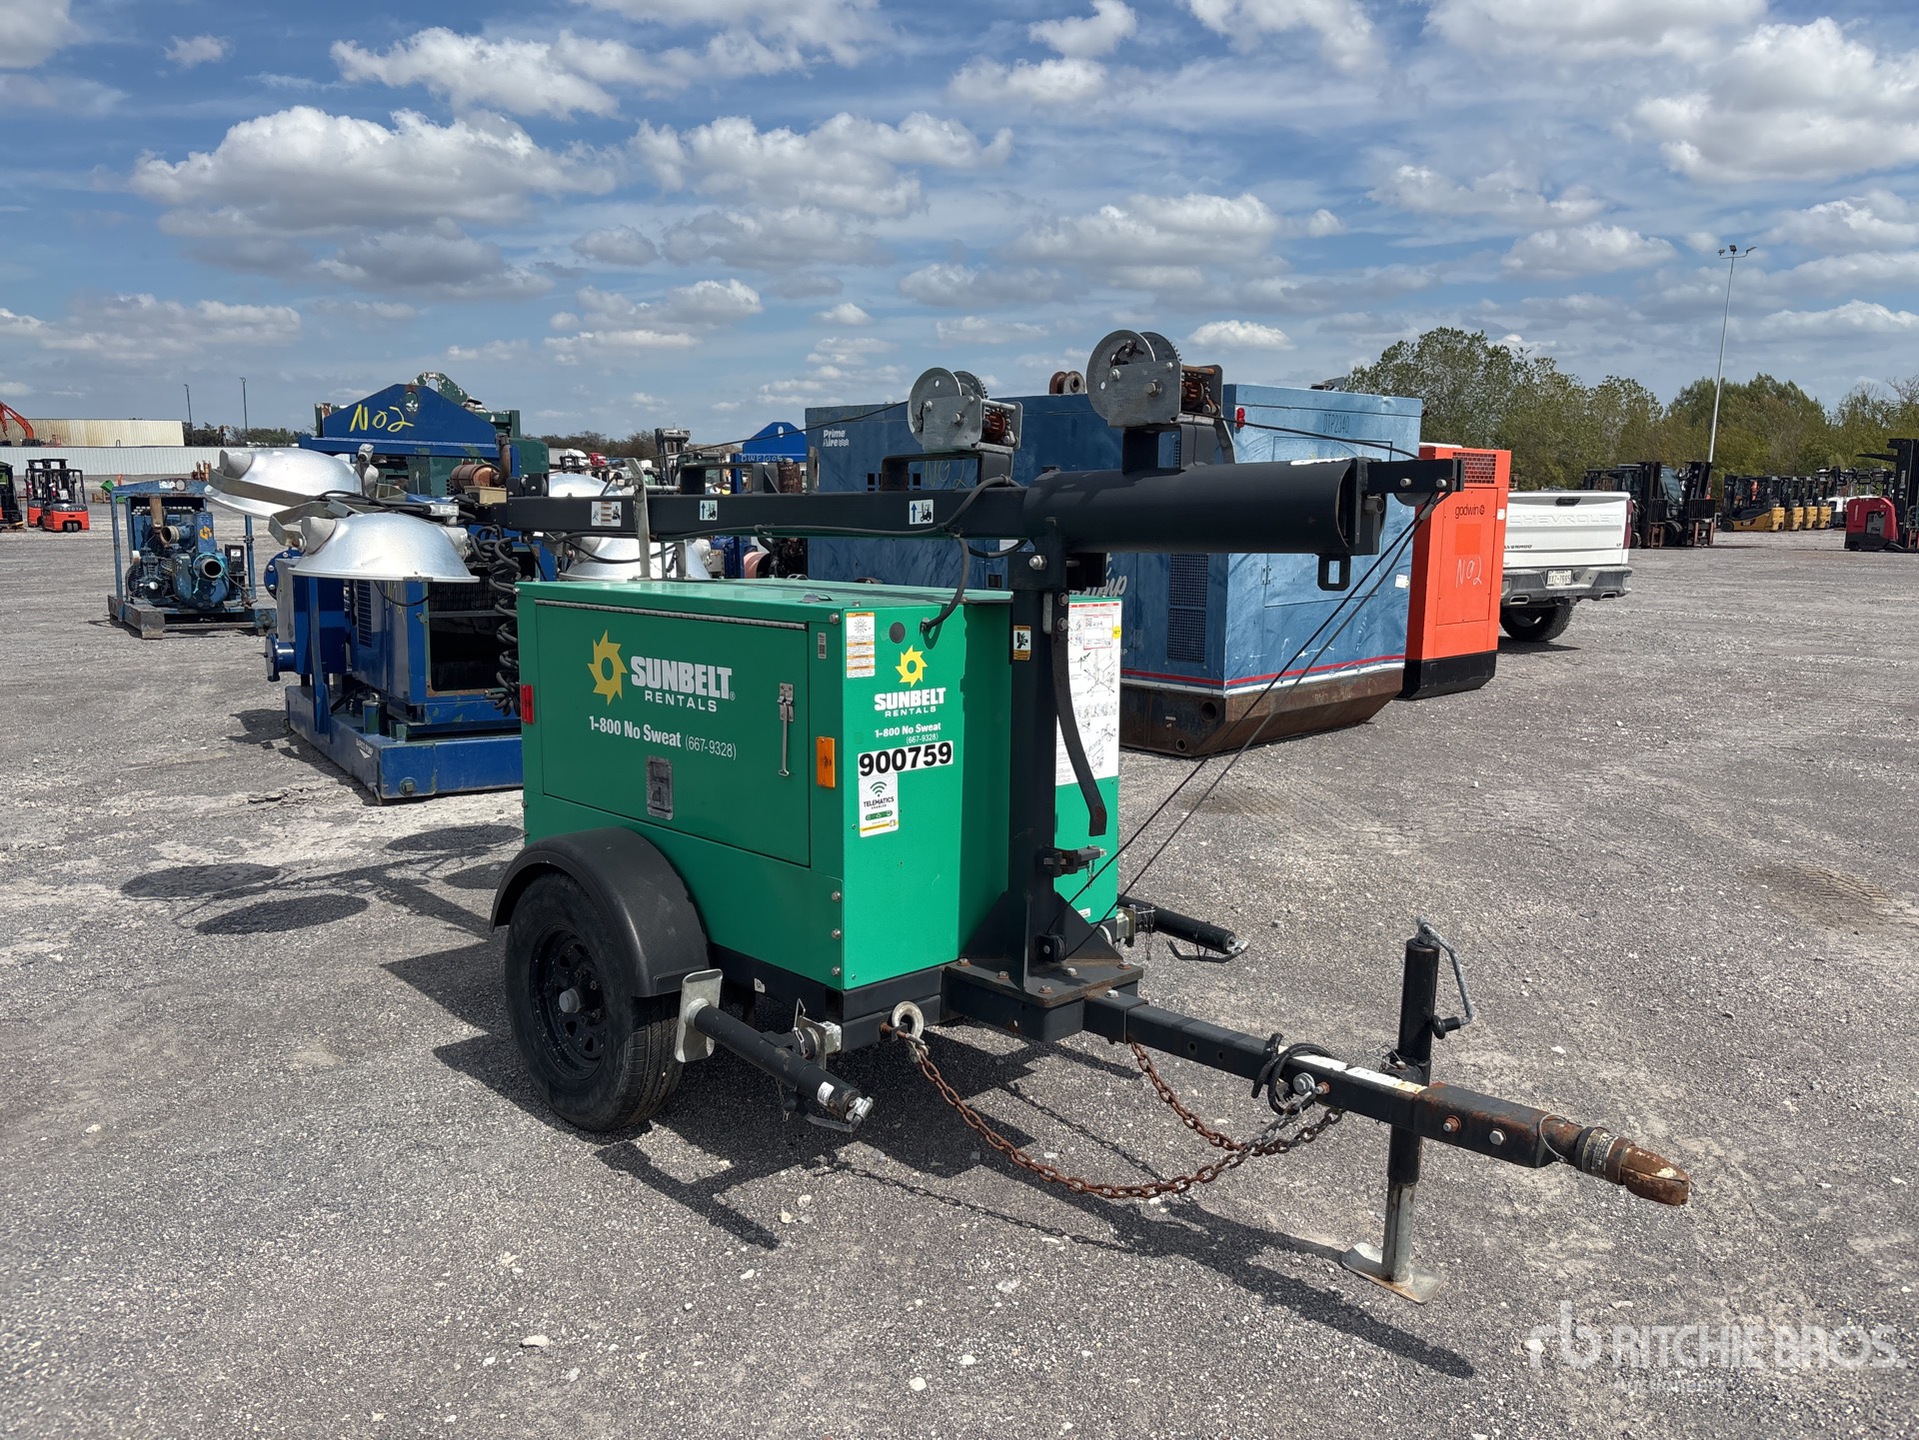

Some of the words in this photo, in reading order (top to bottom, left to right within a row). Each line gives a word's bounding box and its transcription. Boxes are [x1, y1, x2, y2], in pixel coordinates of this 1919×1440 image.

[823, 429, 846, 438] Prime
[1455, 504, 1479, 519] godwin
[1508, 514, 1621, 525] CHEVROLET
[630, 655, 732, 700] SUNBELT
[645, 690, 717, 713] RENTALS
[874, 687, 946, 711] SUNBELT
[884, 705, 937, 718] RENTALS
[875, 727, 900, 738] 1-800
[902, 725, 914, 734] No
[915, 722, 942, 733] Sweat
[589, 716, 621, 735] 1-800
[624, 720, 641, 739] No
[643, 724, 681, 747] Sweat
[685, 734, 737, 761] (667-9328)
[906, 734, 938, 745] (667-9328)
[859, 742, 952, 777] 900759
[863, 796, 895, 807] TELEMATICS
